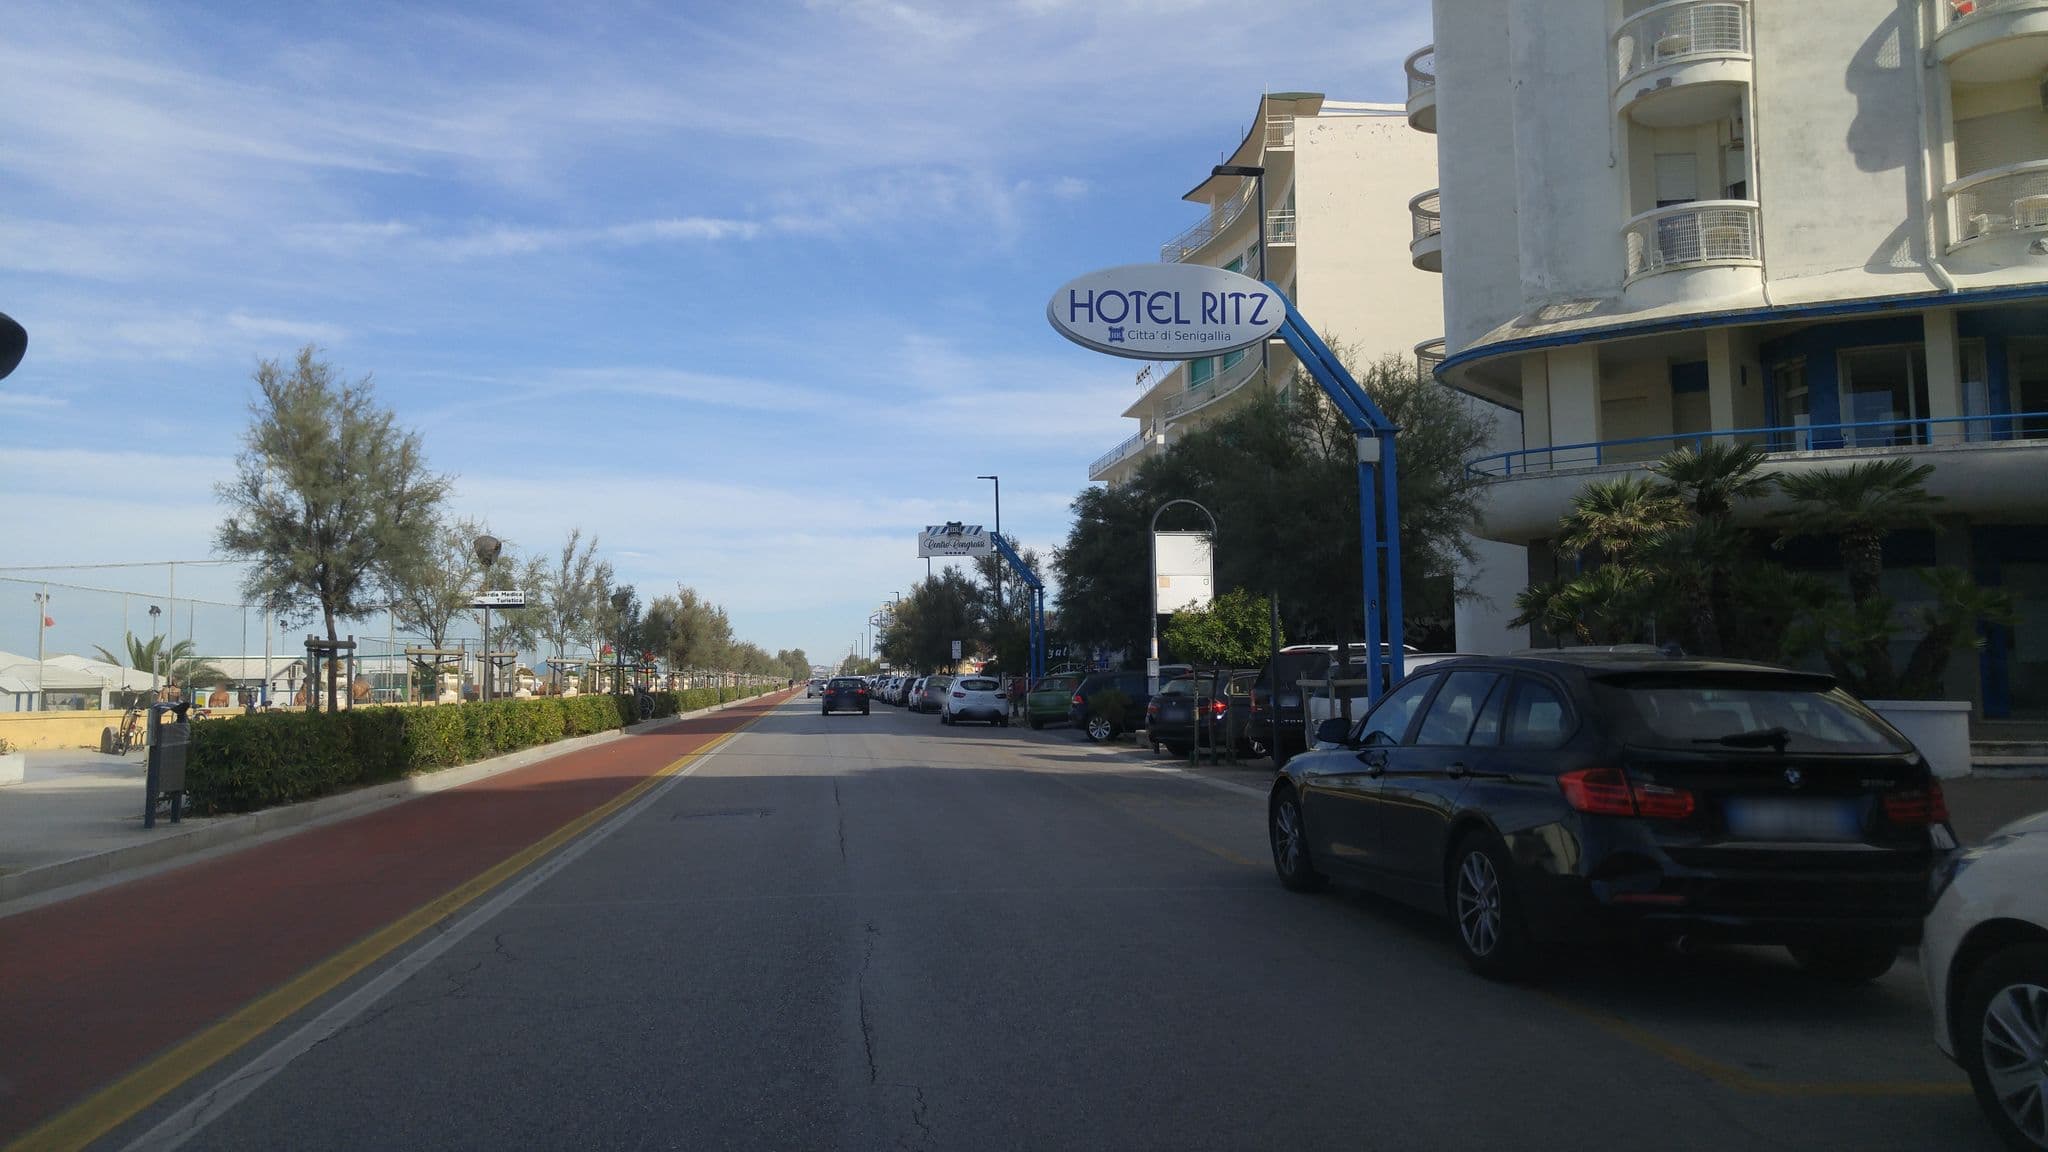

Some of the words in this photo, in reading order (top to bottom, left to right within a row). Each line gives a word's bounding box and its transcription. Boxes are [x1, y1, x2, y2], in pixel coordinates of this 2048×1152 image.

[1070, 289, 1191, 325] HOTEL
[1202, 291, 1269, 326] RITZ
[1160, 330, 1171, 341] di
[1174, 330, 1231, 343] Senigallia
